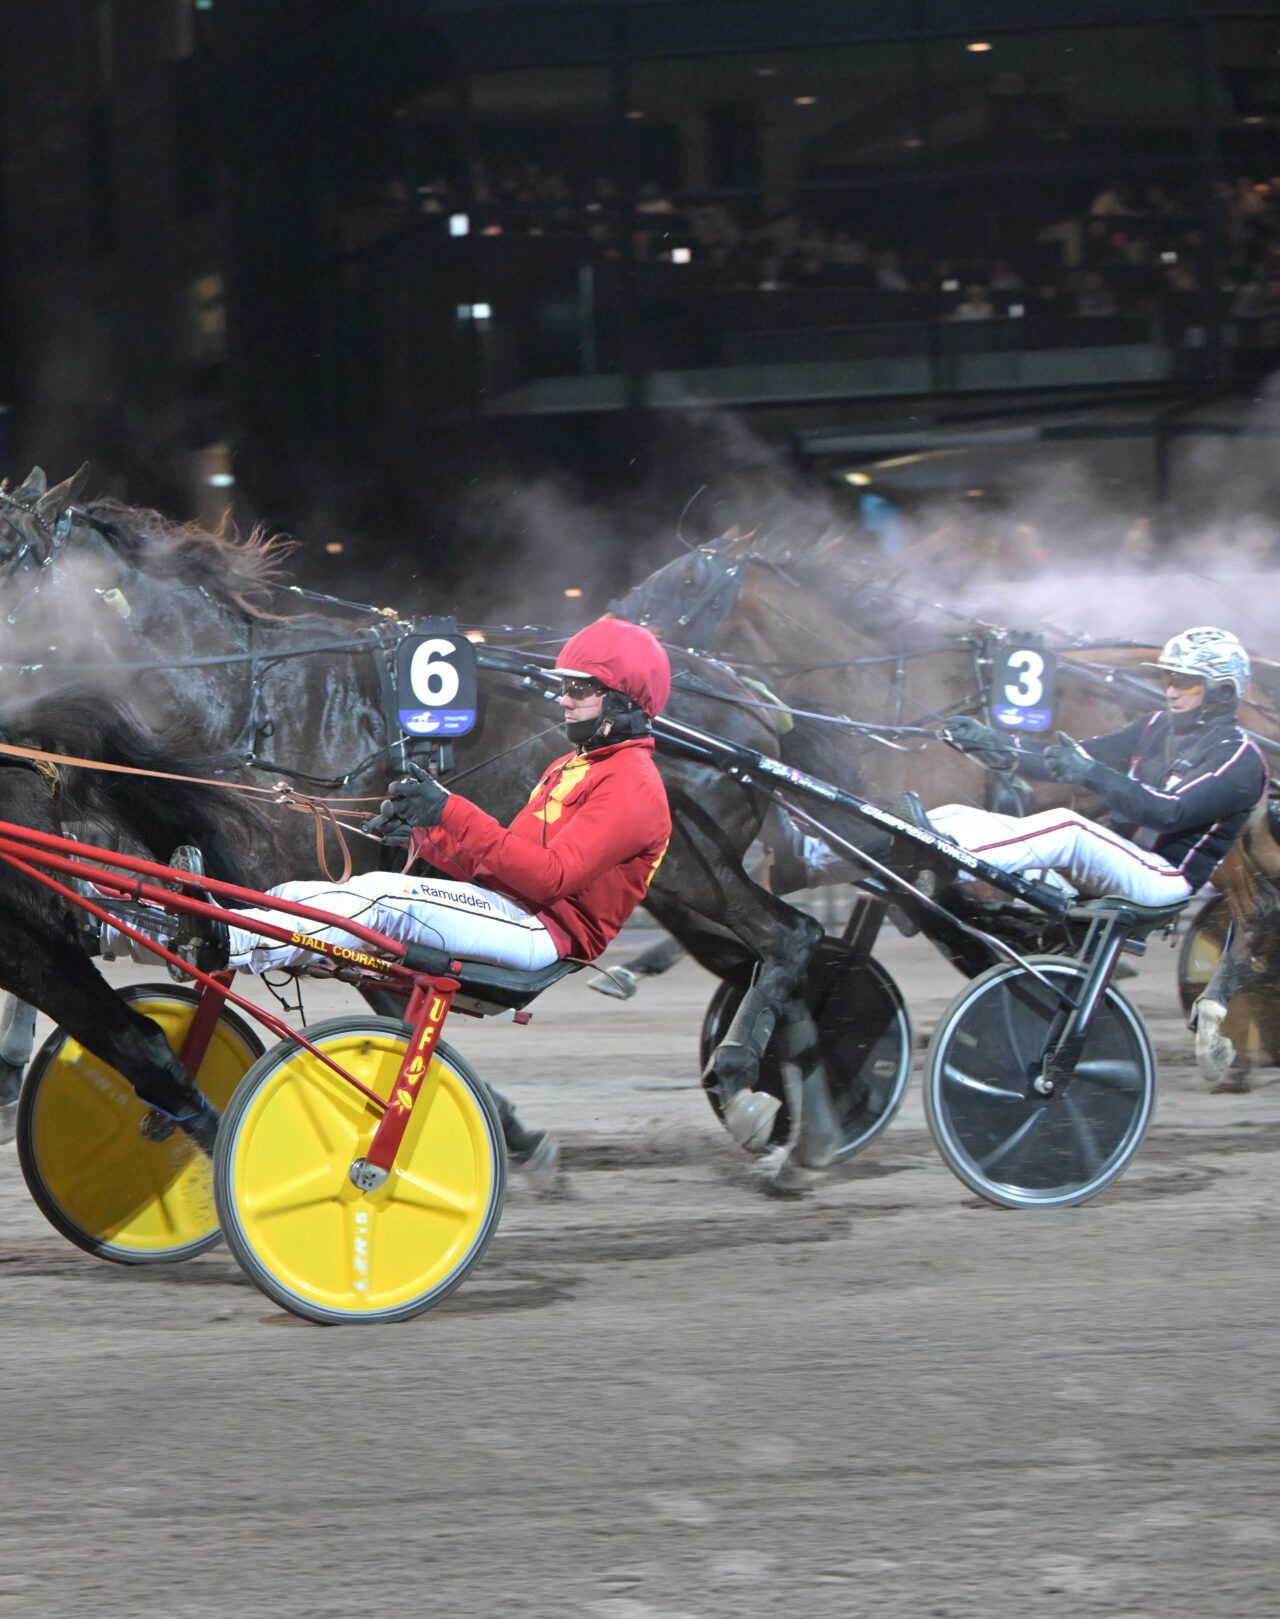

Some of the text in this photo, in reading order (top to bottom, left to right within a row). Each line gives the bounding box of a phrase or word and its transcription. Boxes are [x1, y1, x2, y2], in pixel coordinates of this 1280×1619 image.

[410, 638, 459, 706] 6
[1004, 649, 1044, 707] 3
[420, 884, 491, 911] Ramudden
[291, 932, 392, 972] STALL COURANT
